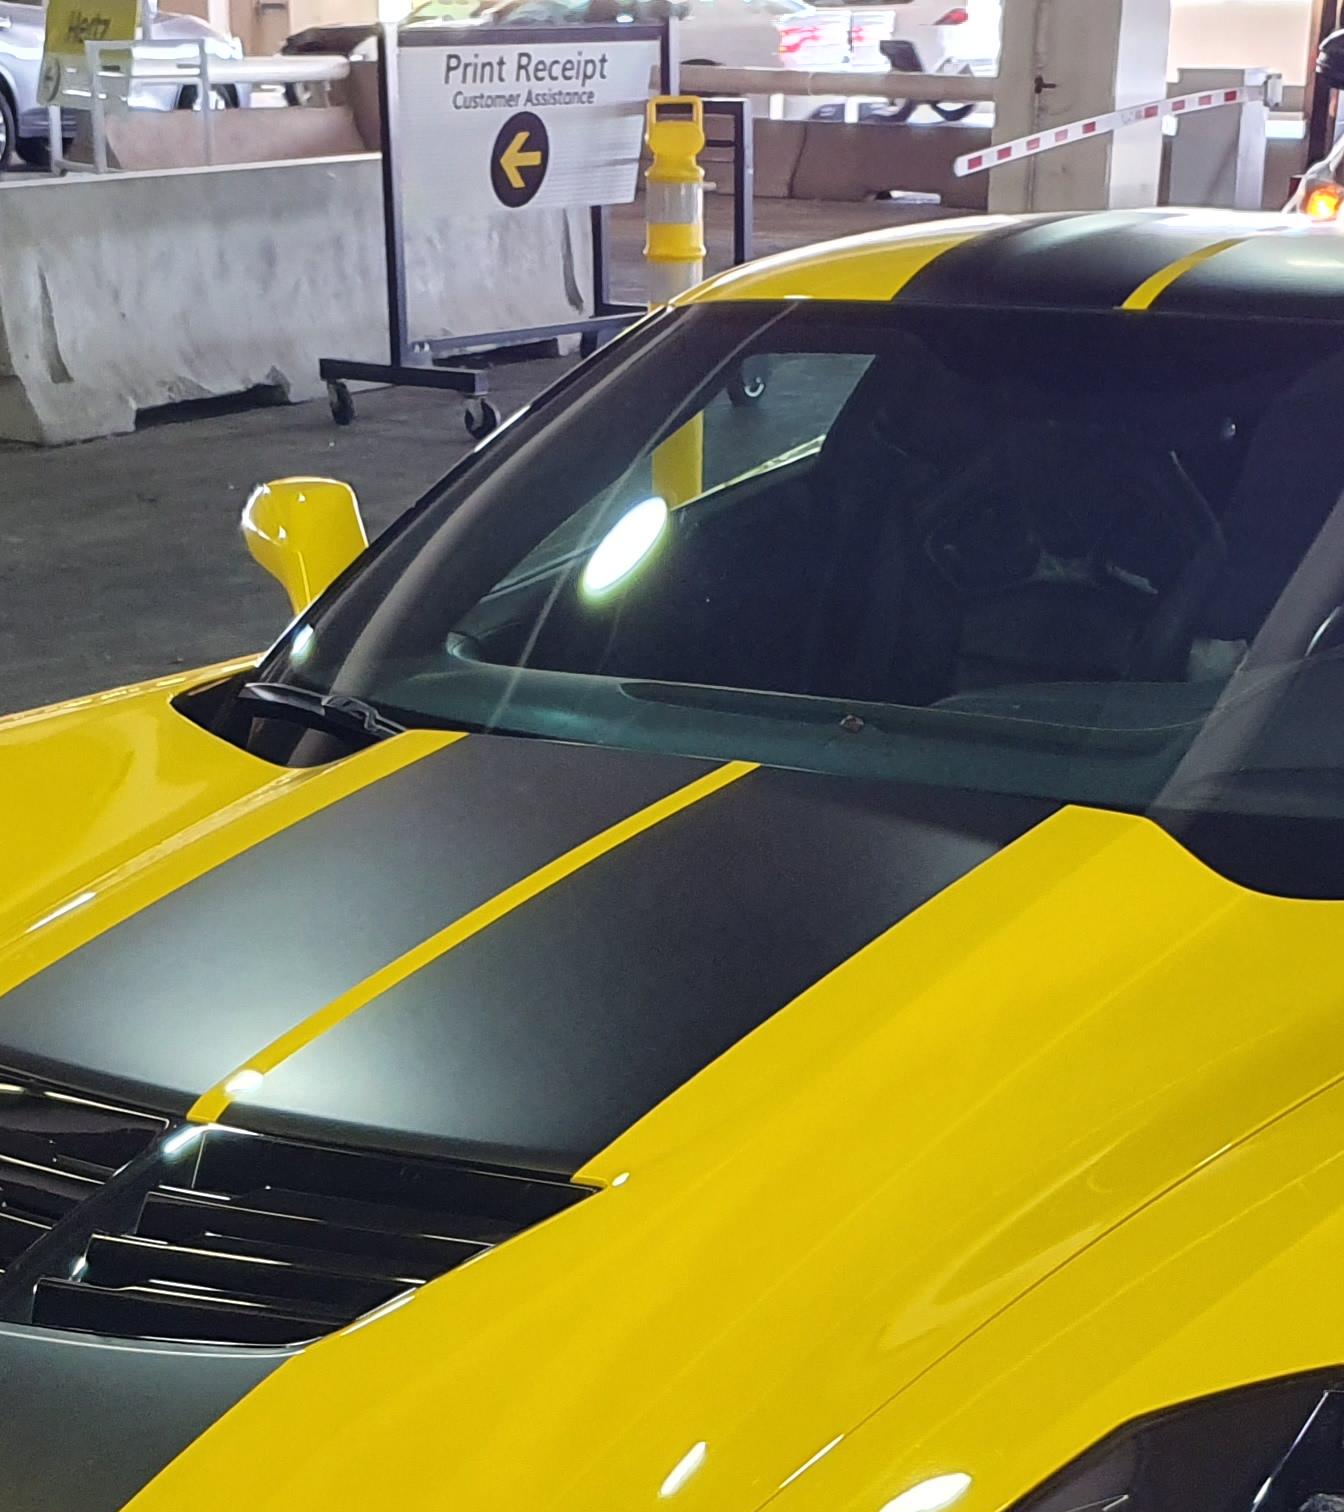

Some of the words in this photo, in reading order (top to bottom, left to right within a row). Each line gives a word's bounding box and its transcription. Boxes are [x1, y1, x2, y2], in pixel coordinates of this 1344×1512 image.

[444, 53, 506, 85] Print
[515, 50, 609, 88] Receipt
[452, 90, 522, 110] Customer
[523, 88, 596, 107] Assistance
